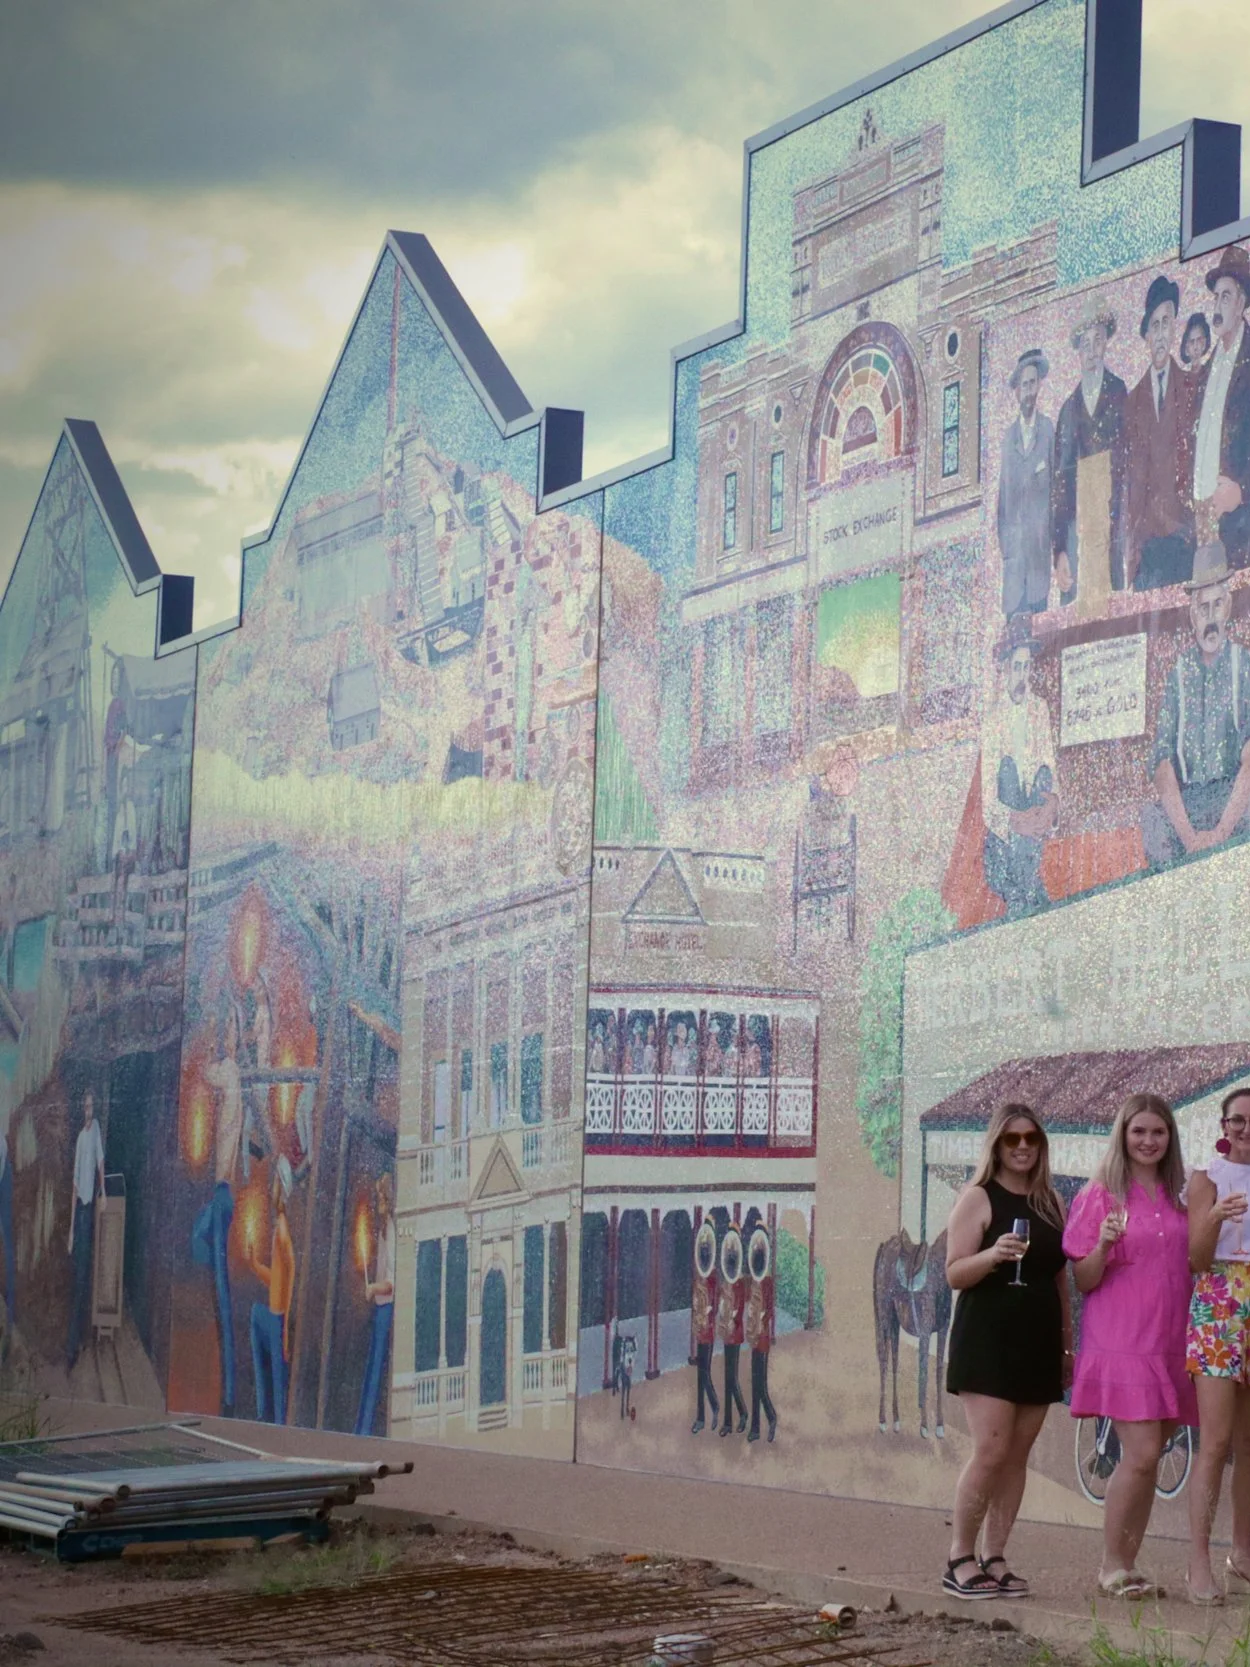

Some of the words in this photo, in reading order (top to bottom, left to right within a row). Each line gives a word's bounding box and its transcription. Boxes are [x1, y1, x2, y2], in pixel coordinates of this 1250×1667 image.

[823, 523, 849, 545] STOCK
[852, 506, 898, 536] EXCHANGE
[926, 1133, 983, 1160] TIMBE
